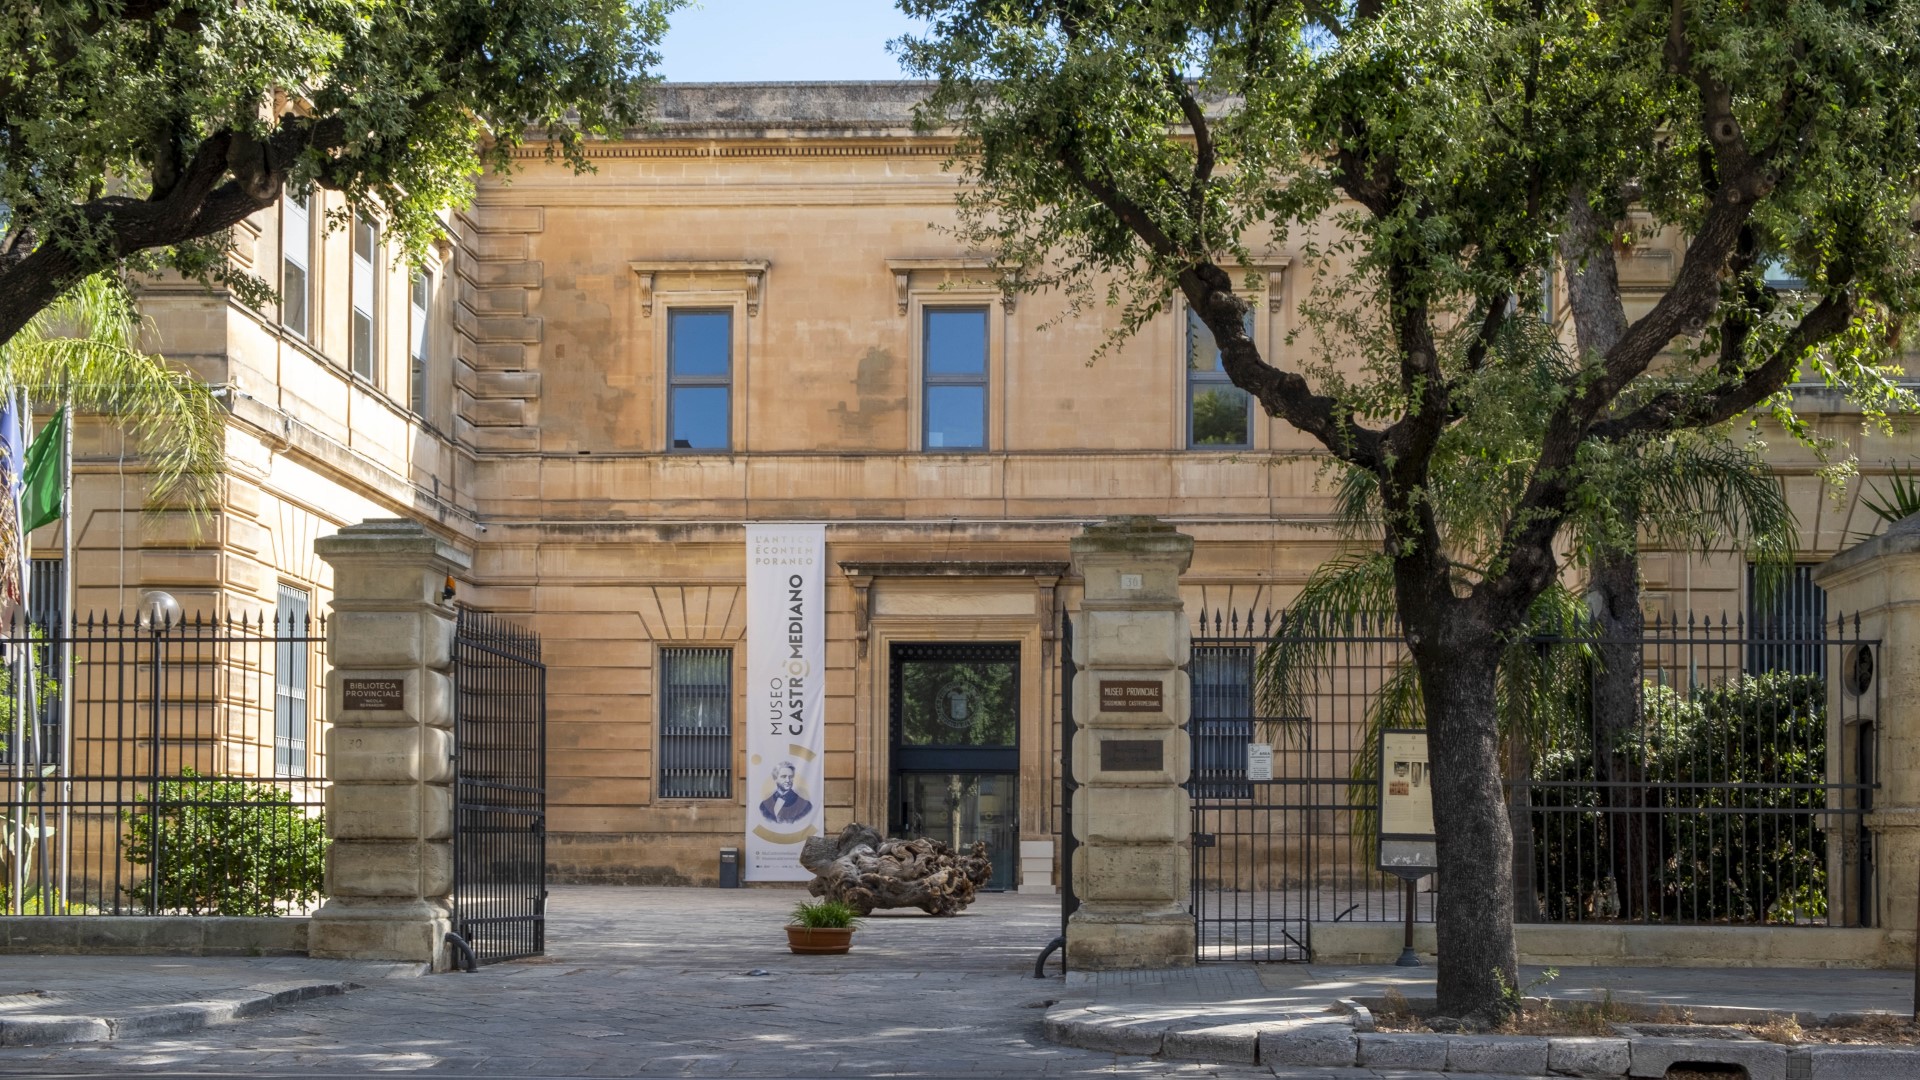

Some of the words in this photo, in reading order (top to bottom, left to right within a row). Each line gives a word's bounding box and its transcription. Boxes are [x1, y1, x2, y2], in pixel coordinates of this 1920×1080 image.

[755, 536, 813, 544] L'ANTICO
[755, 557, 813, 565] PORANEO
[788, 574, 804, 736] CASTROMEDIANO
[349, 682, 397, 690] BIBLIOTECA
[345, 690, 401, 698] PROVINCIALE
[1104, 687, 1123, 696] MUSEO
[1126, 687, 1159, 697] PROVINCIALE
[770, 677, 783, 735] MUSEO
